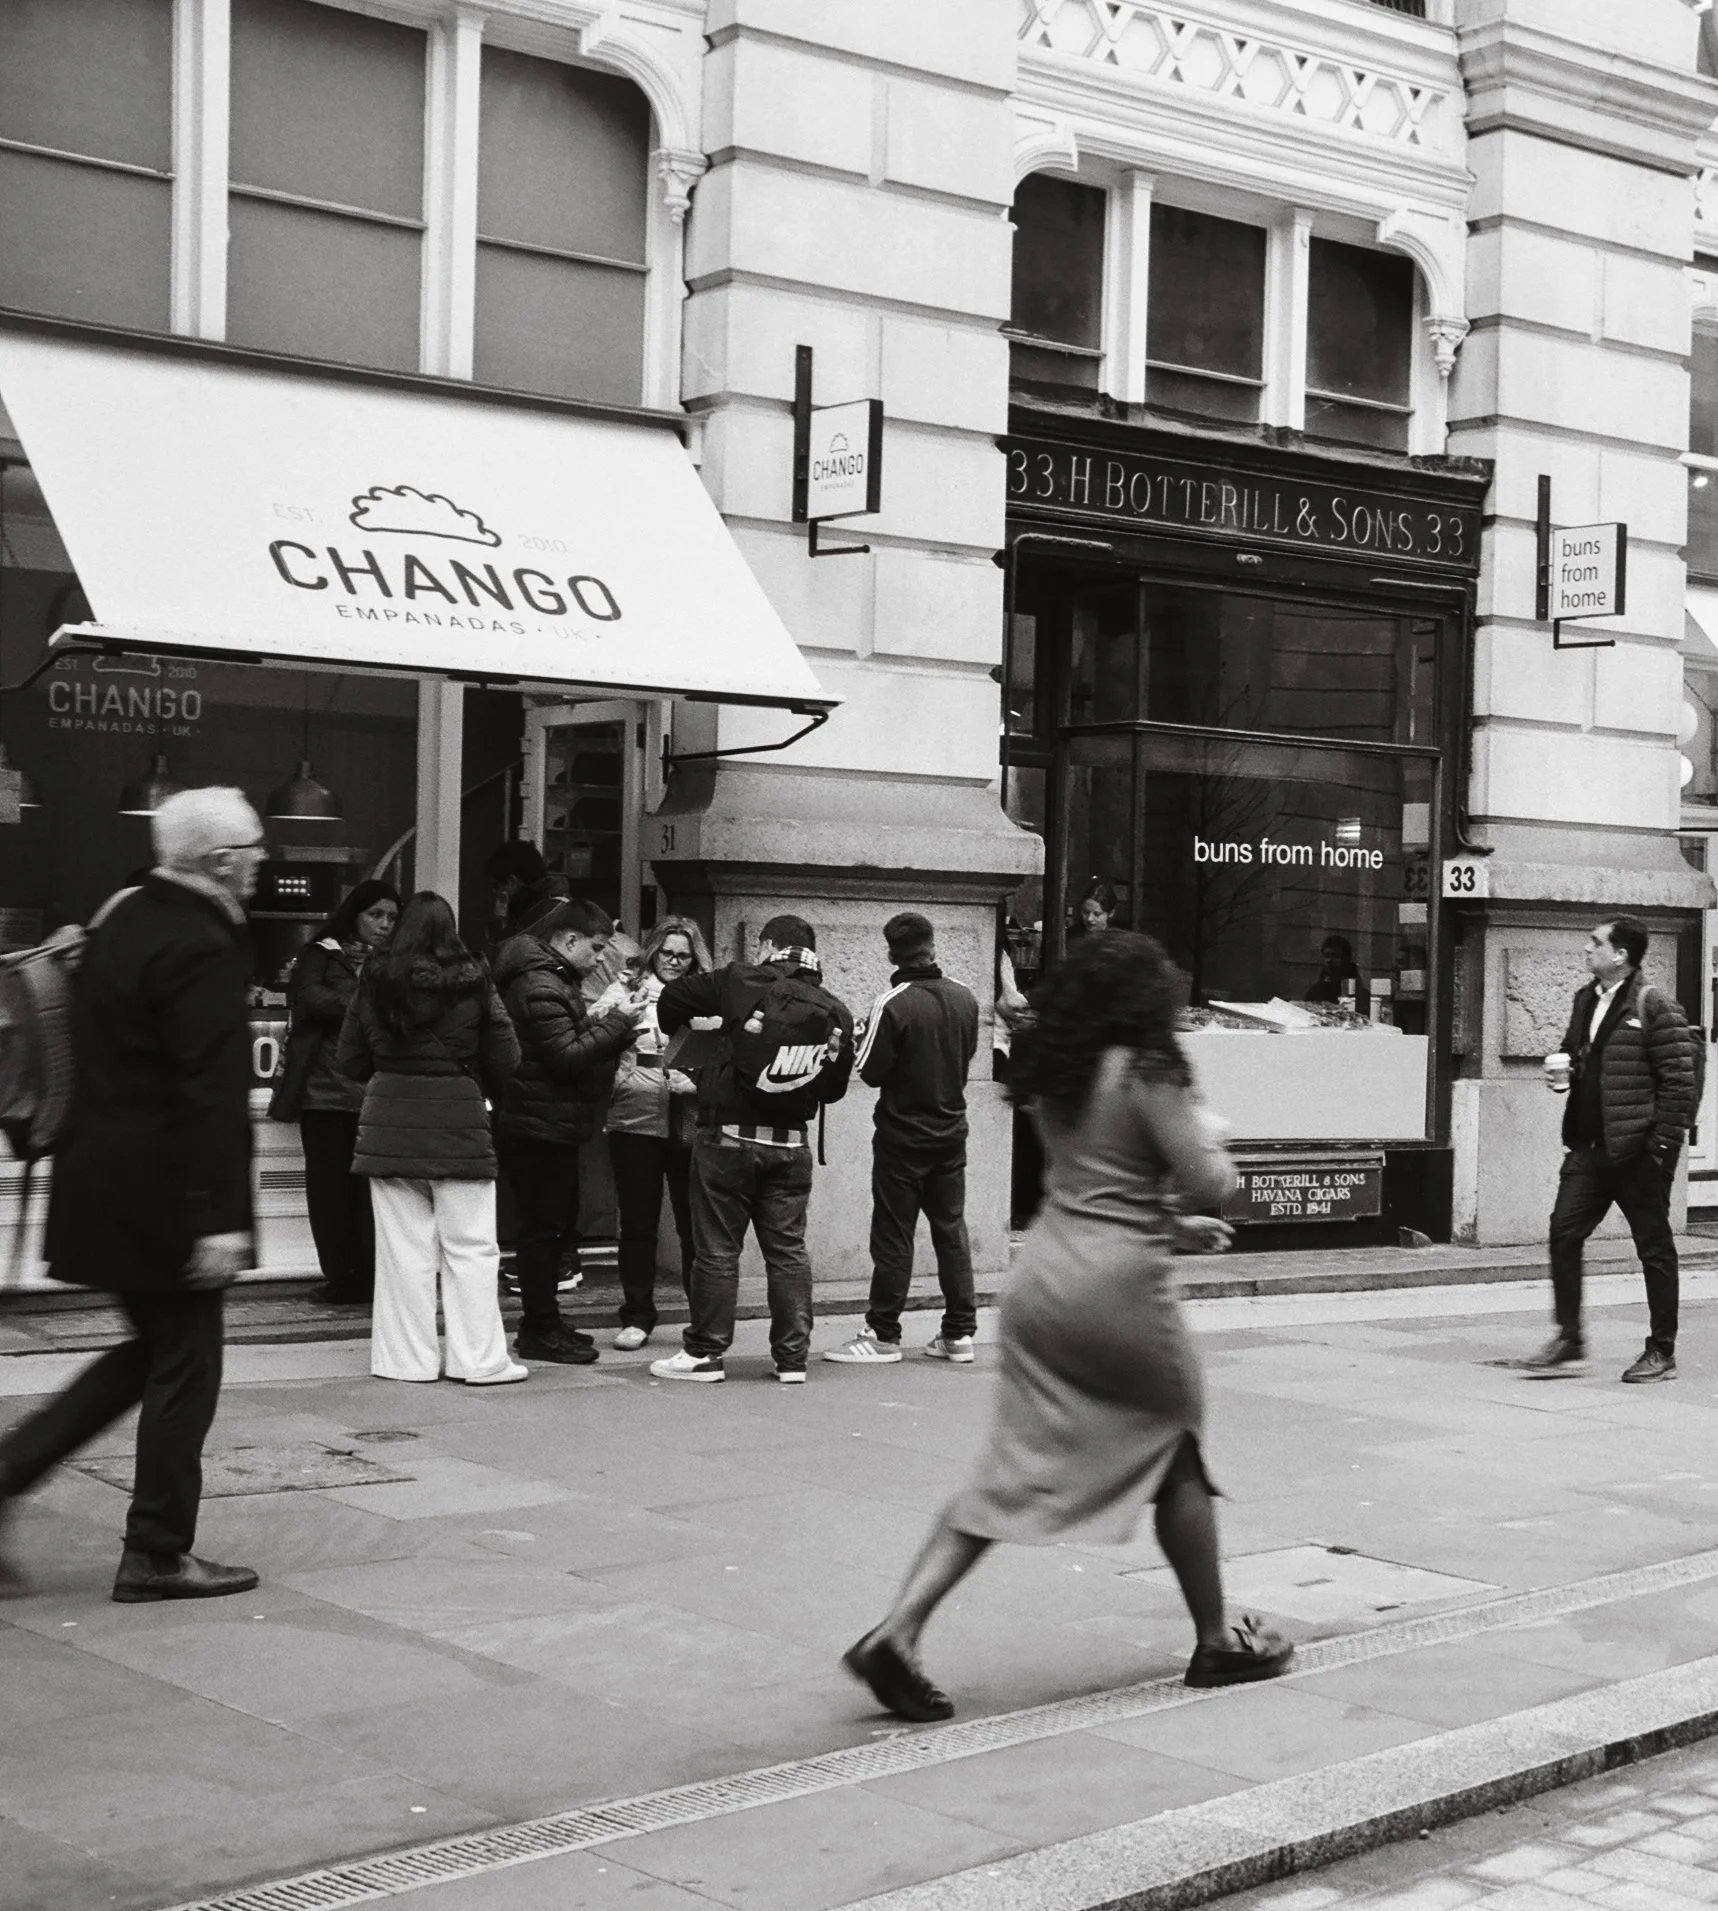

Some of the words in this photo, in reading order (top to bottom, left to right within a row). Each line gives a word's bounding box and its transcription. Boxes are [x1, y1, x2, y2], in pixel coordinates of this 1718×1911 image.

[812, 453, 864, 481] CHANGO
[1105, 461, 1289, 534] BOTTERILL
[1295, 497, 1320, 537] &
[1426, 514, 1463, 556] 33
[517, 534, 568, 554] 2010
[1561, 538, 1601, 558] buns
[268, 540, 622, 622] CHANGO
[1561, 563, 1599, 584] from
[1560, 589, 1607, 609] home
[335, 604, 527, 635] EMPANADAS
[552, 624, 589, 642] UK
[168, 665, 198, 680] 2010
[49, 680, 203, 721] CHANGO
[48, 717, 156, 735] EMPANADAS
[172, 725, 193, 737] UK
[660, 824, 675, 854] 31
[1193, 836, 1253, 863] buns
[1259, 838, 1313, 865] from
[1320, 841, 1384, 869] home
[1449, 866, 1476, 892] 33
[769, 1043, 829, 1076] NIKE
[1235, 1175, 1246, 1189] H
[1334, 1173, 1366, 1186] SONS
[1251, 1189, 1303, 1203] HAVANA
[1308, 1187, 1351, 1201] CIGARS
